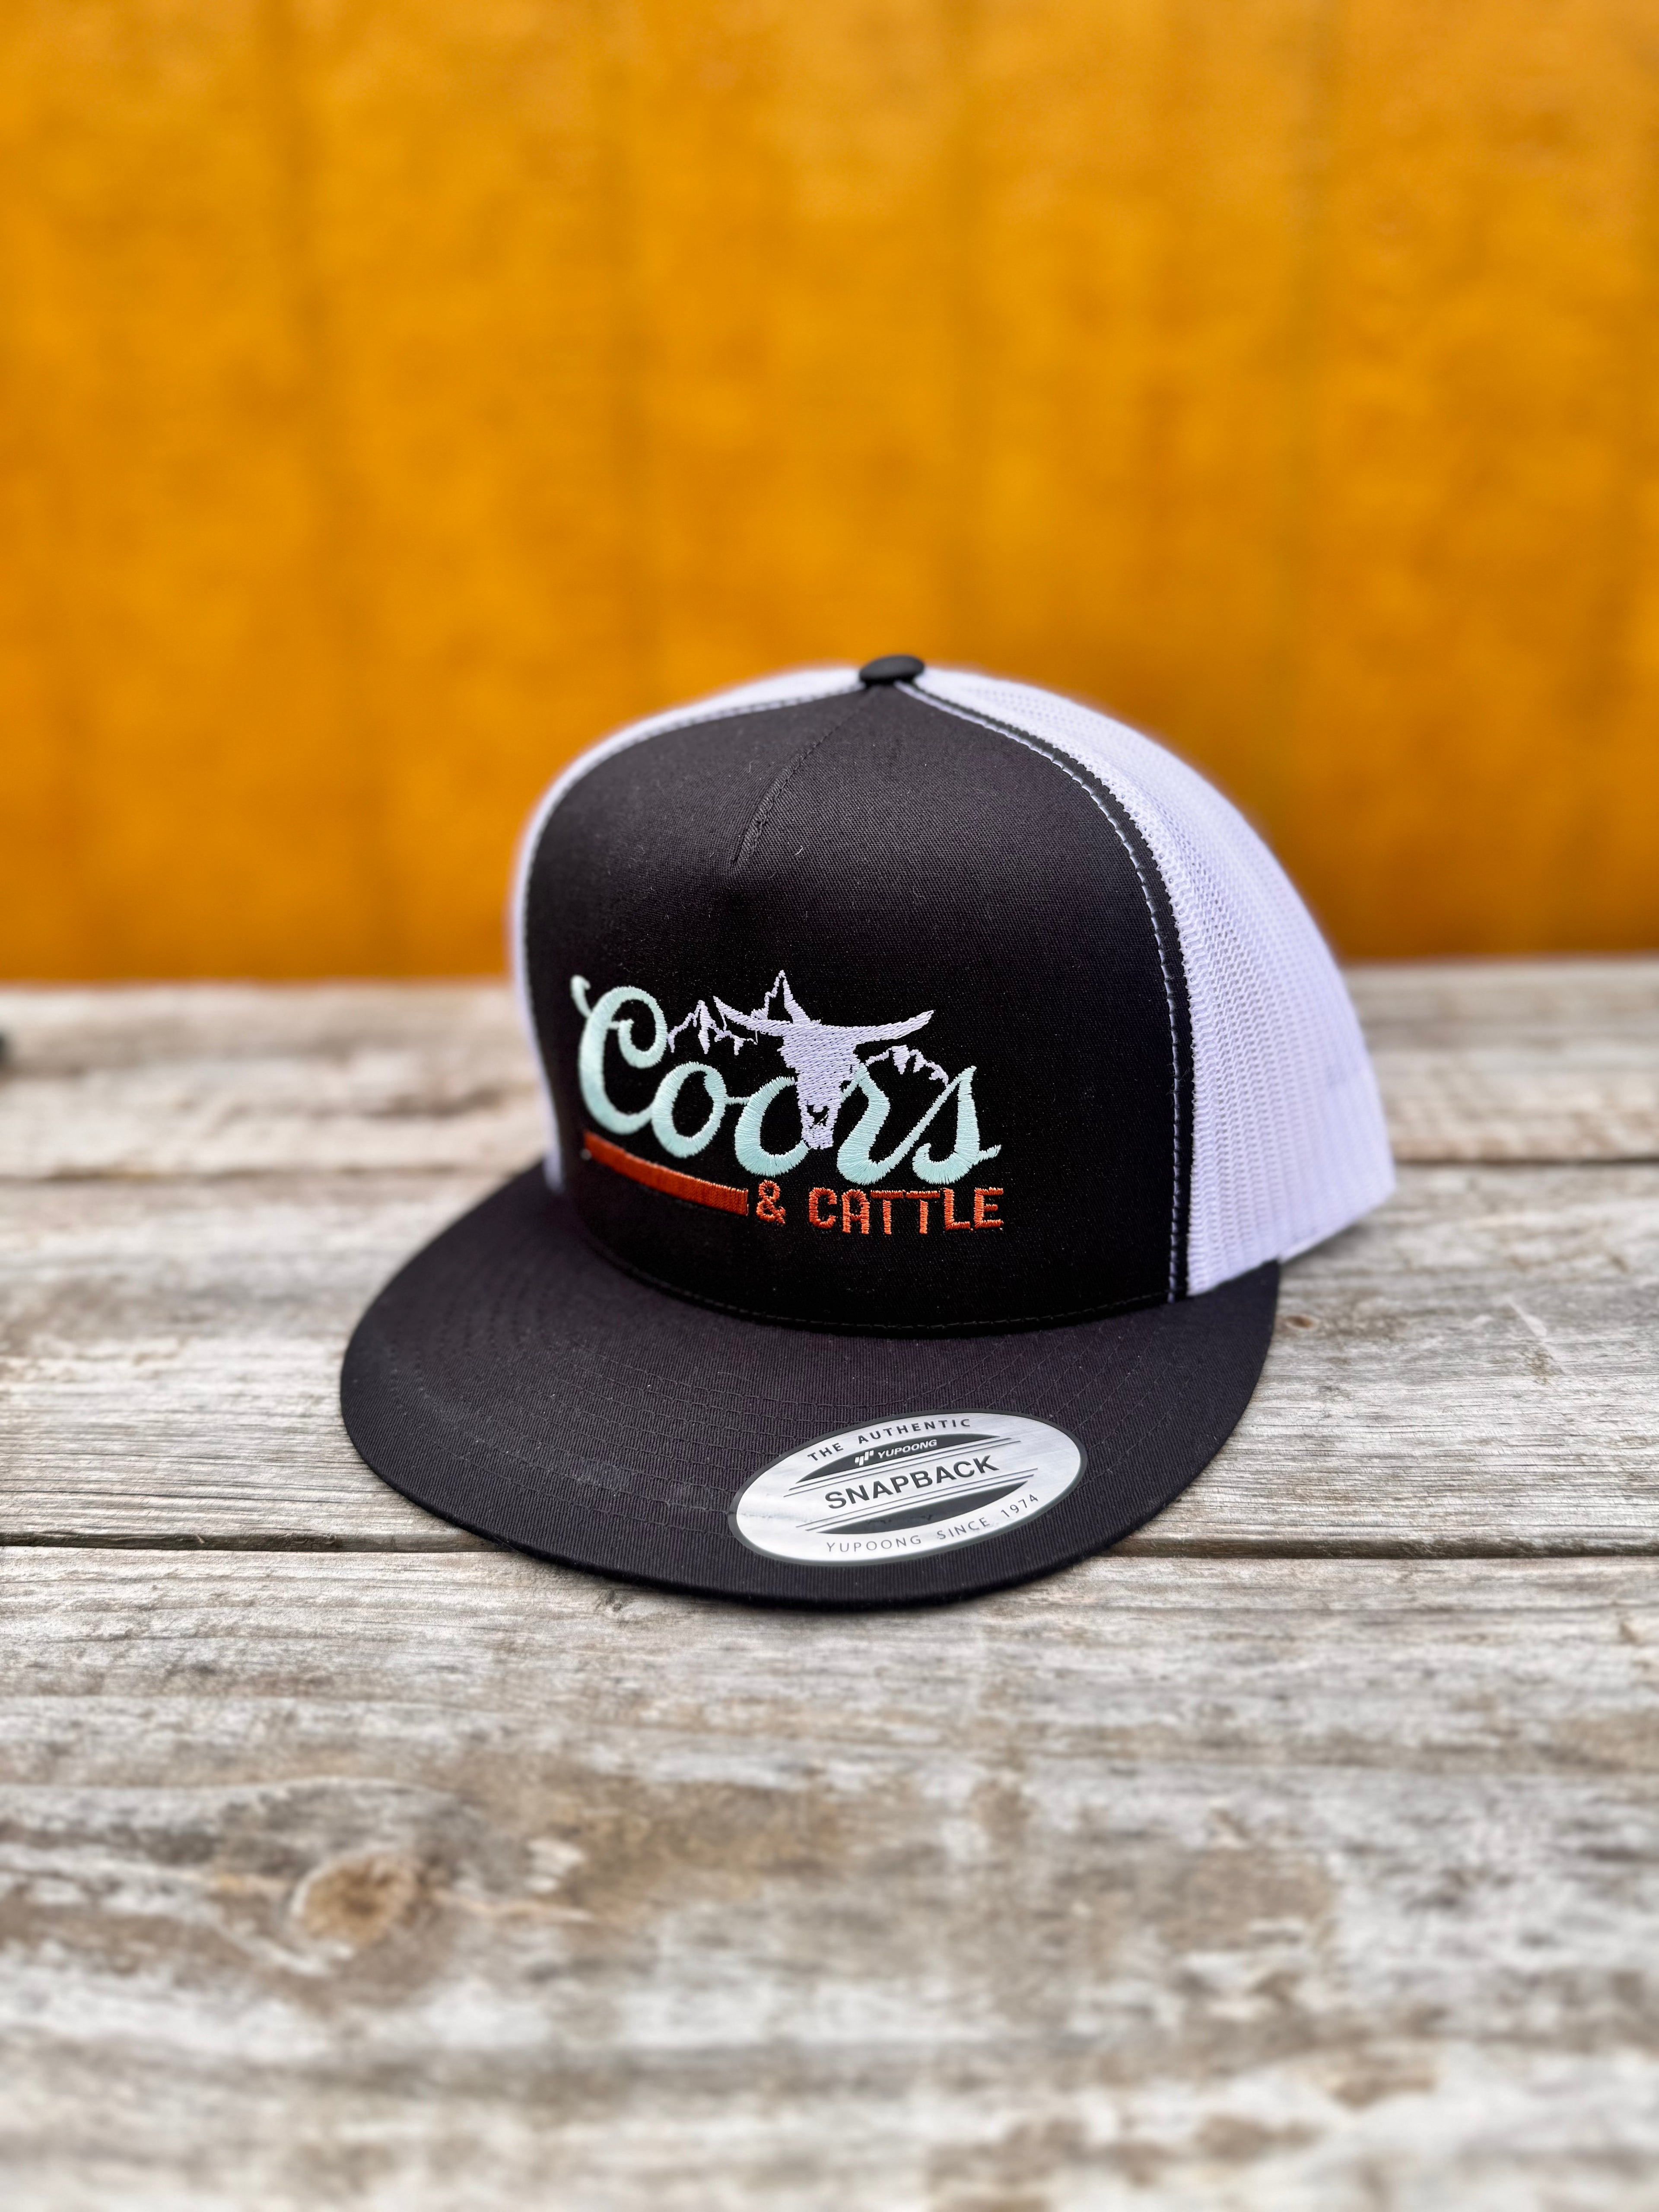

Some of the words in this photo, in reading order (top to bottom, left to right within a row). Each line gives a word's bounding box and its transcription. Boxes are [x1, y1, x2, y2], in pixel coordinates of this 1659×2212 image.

[570, 975, 1001, 1185] Coors
[756, 1180, 785, 1225] &
[808, 1187, 1004, 1234] CATTLE
[807, 1443, 844, 1462] THE
[858, 1418, 971, 1444] AUTHENTIC
[877, 1439, 938, 1459] YUPOONG
[825, 1455, 1000, 1510] SNAPBACK
[826, 1535, 922, 1553] YUPOONG
[937, 1517, 990, 1540] SINCE
[1000, 1494, 1039, 1518] 1974
